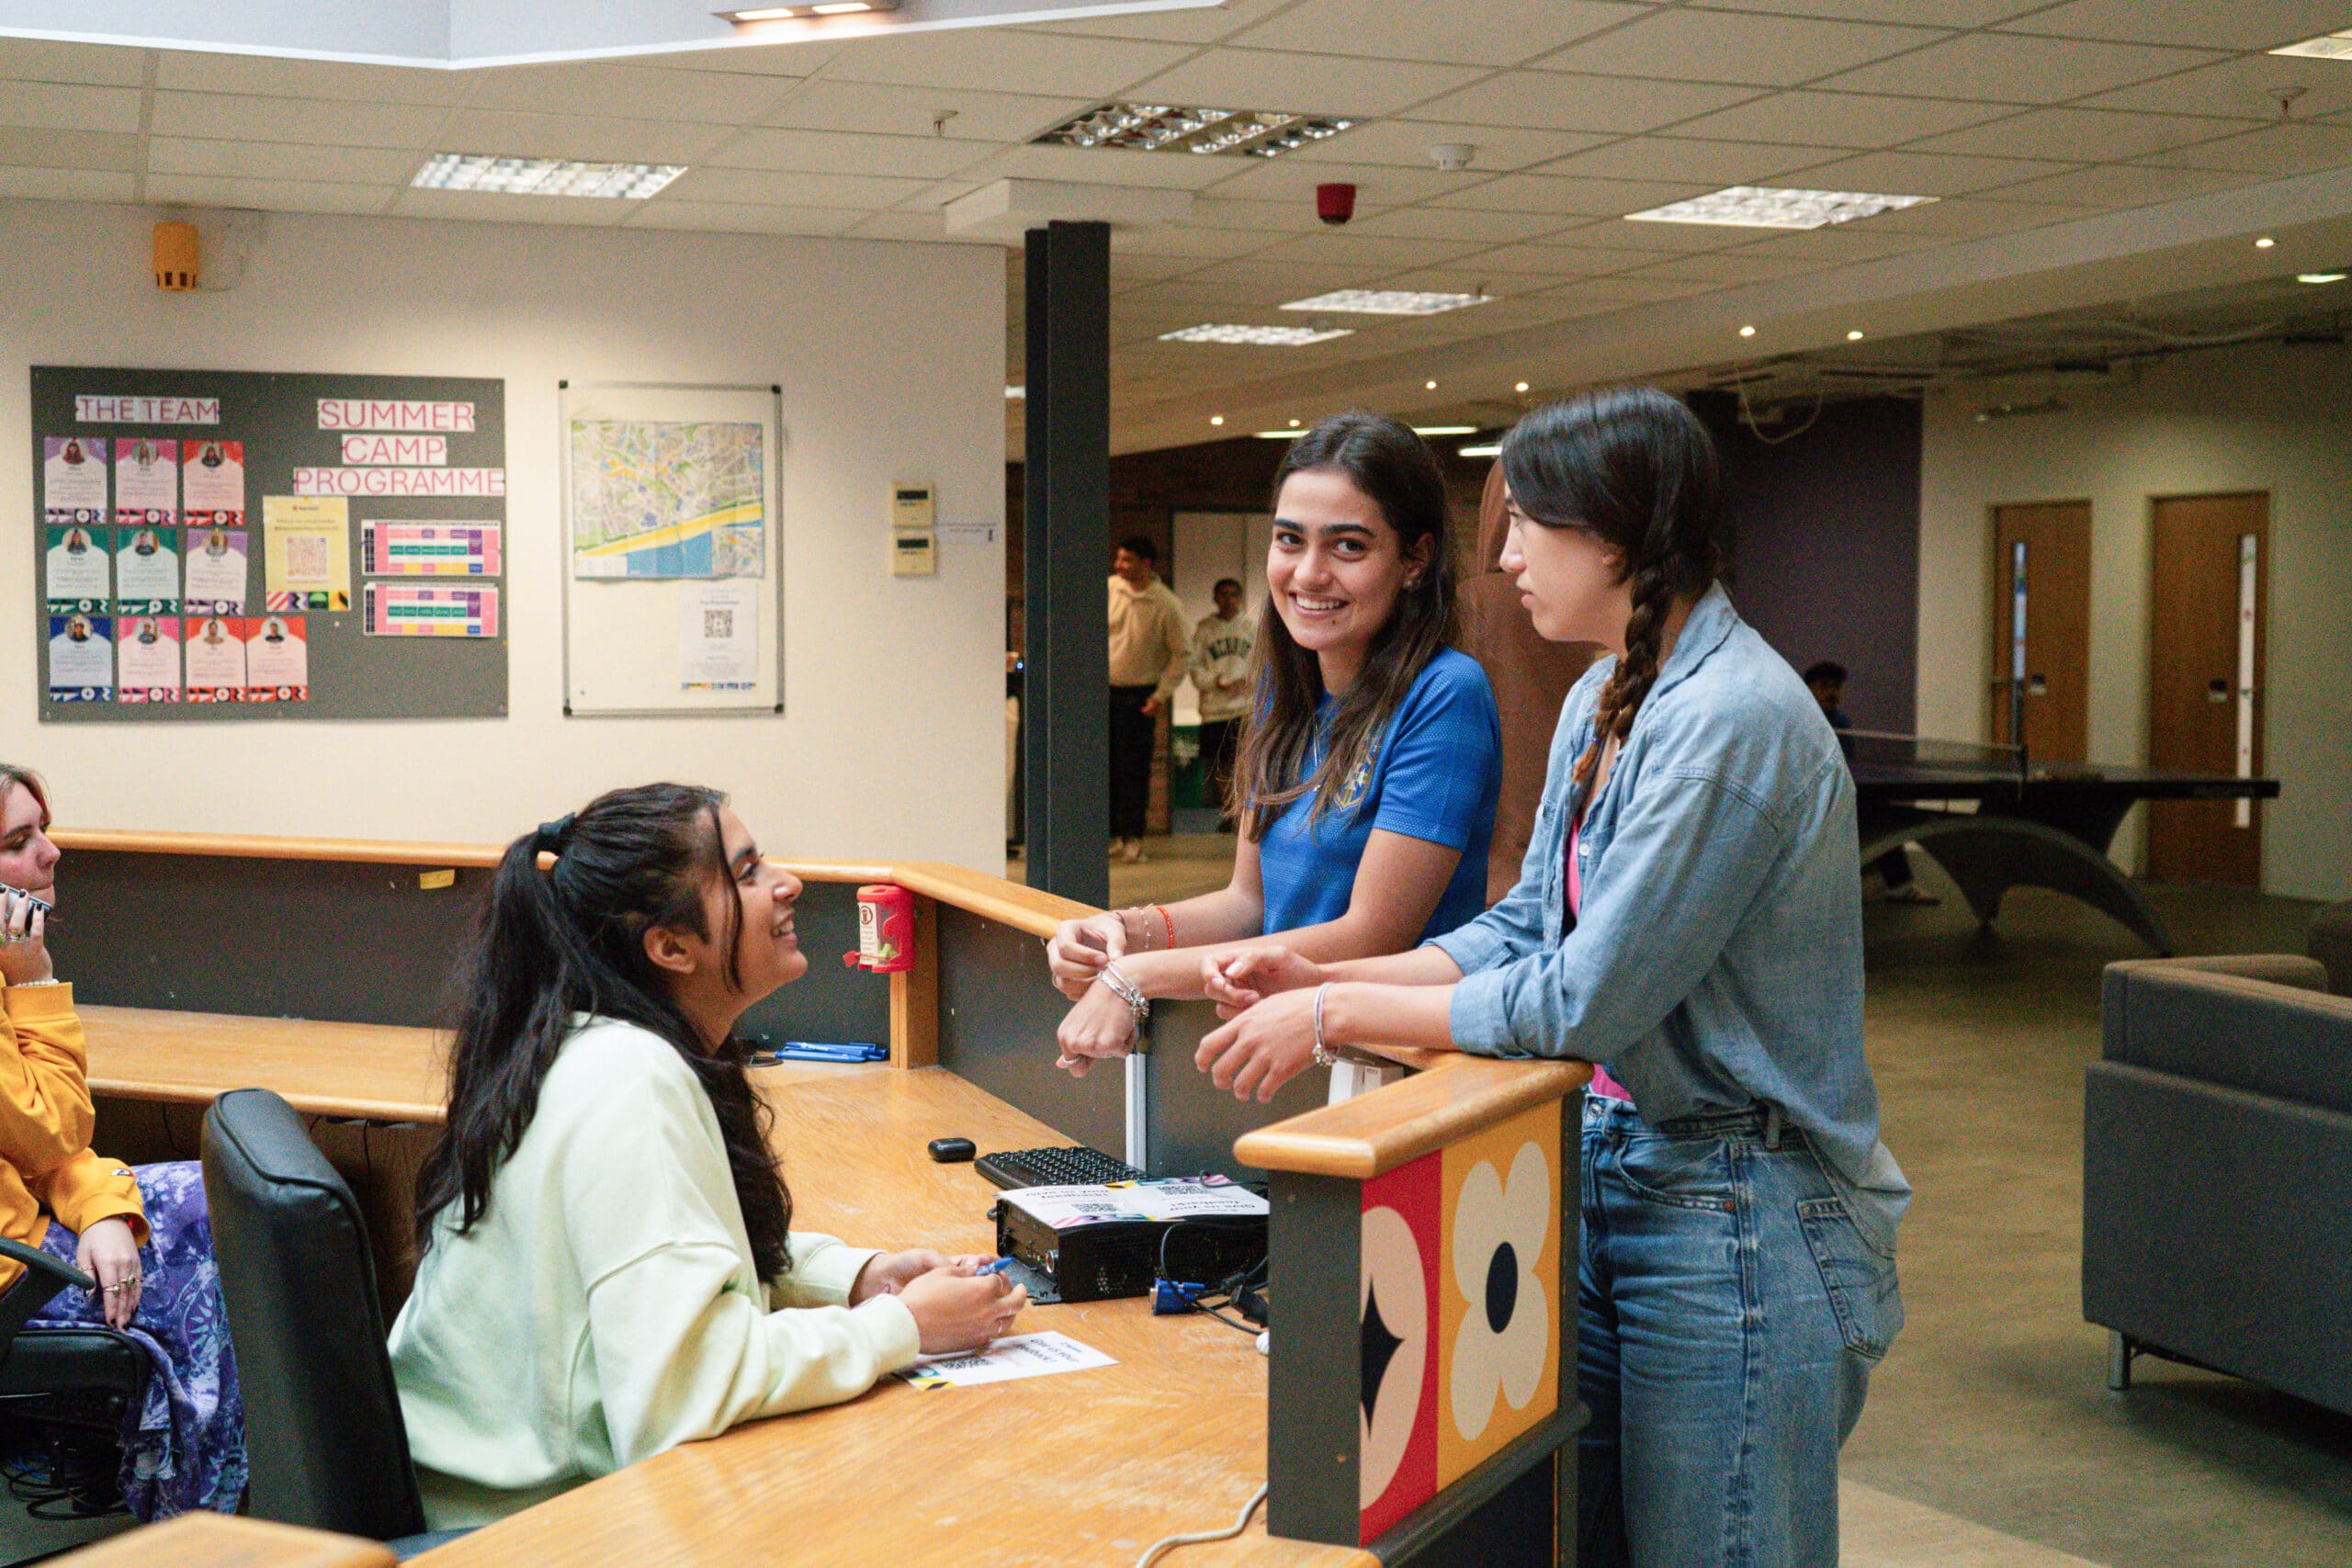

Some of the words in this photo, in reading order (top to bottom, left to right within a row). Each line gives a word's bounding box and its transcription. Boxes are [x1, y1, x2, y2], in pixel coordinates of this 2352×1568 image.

[80, 397, 134, 421] THE
[142, 399, 219, 422] TEAM
[321, 400, 473, 430] SUMMER
[344, 435, 445, 464] CAMP
[294, 468, 504, 494] PROGRAMME
